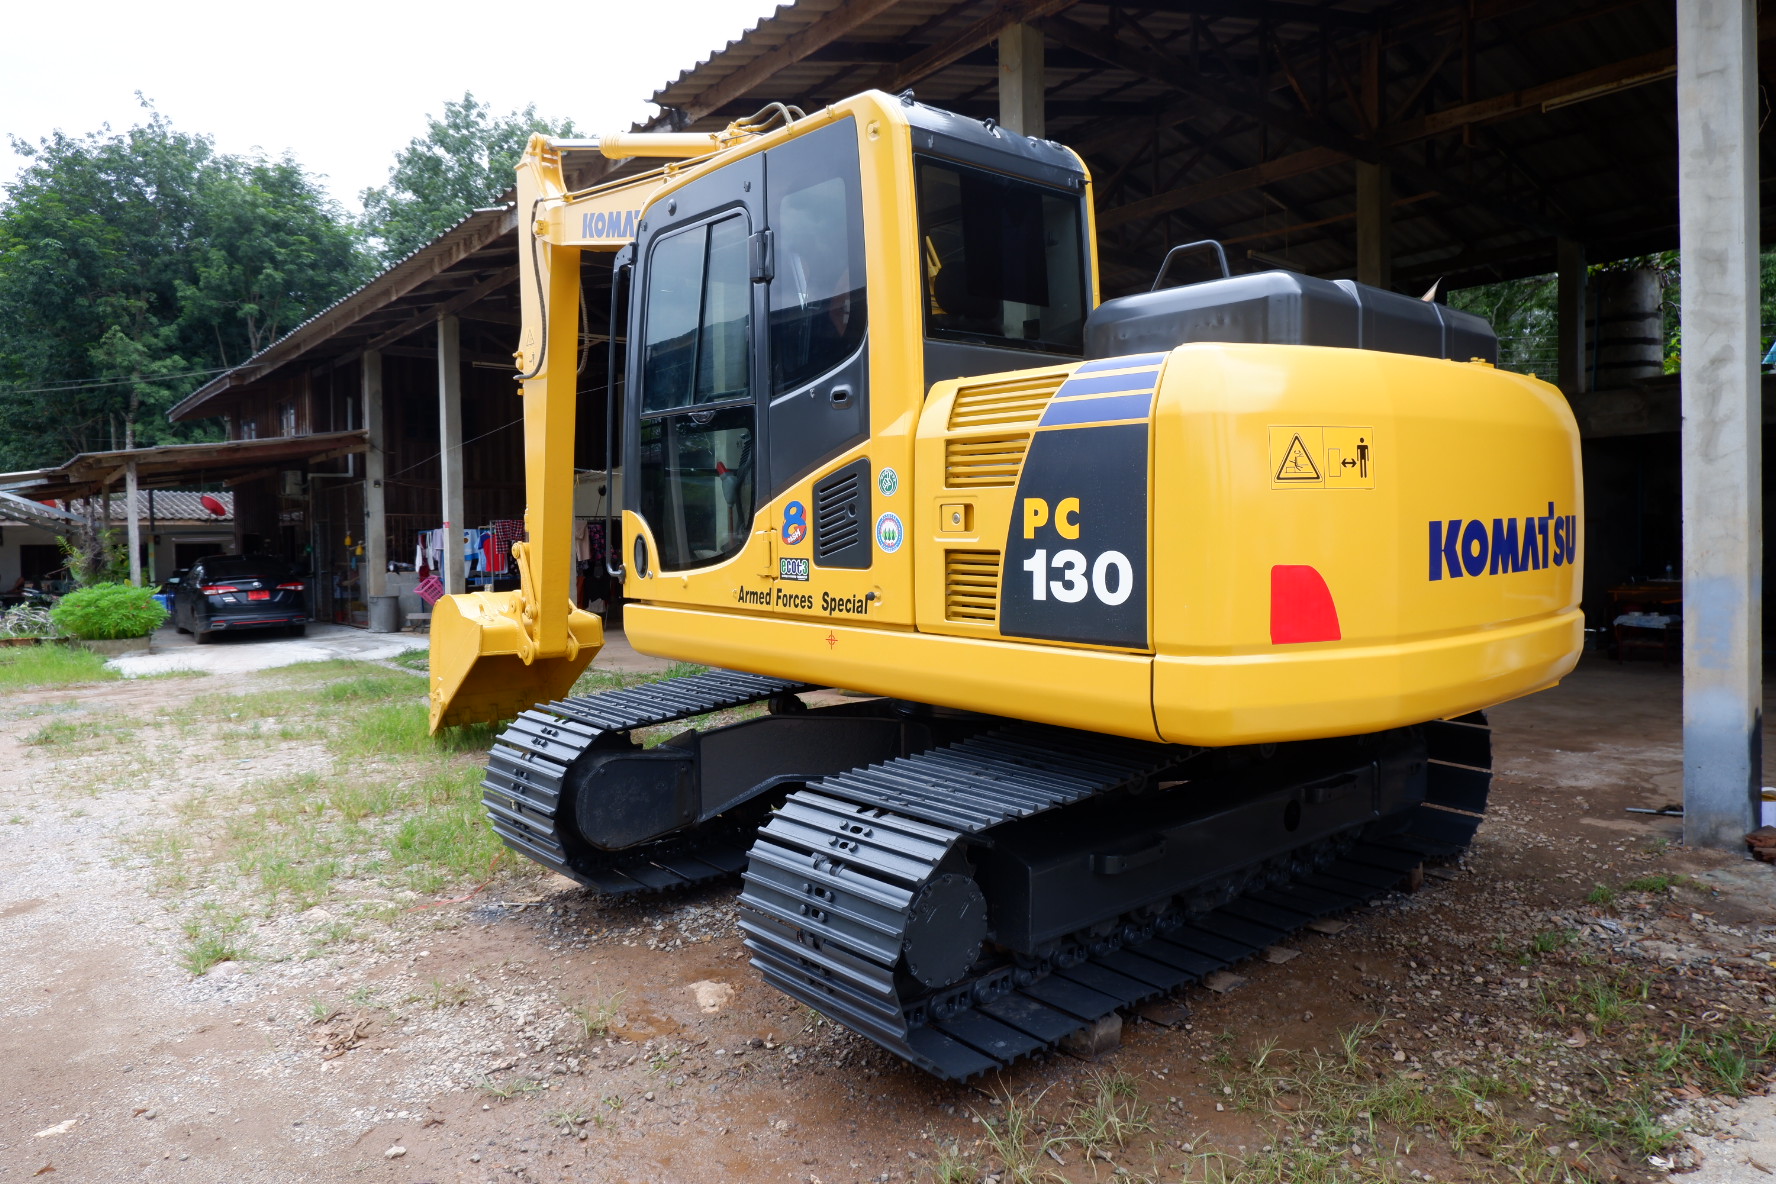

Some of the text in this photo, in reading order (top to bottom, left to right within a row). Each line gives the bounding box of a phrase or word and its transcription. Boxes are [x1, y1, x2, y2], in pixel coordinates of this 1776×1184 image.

[582, 210, 640, 238] KOMA
[782, 501, 807, 545] 8
[1023, 497, 1080, 540] PC
[1429, 501, 1577, 581] KOMATSU
[781, 559, 809, 575] ecot3
[1023, 549, 1134, 606] 130
[738, 585, 868, 616] Armed Forces Special
